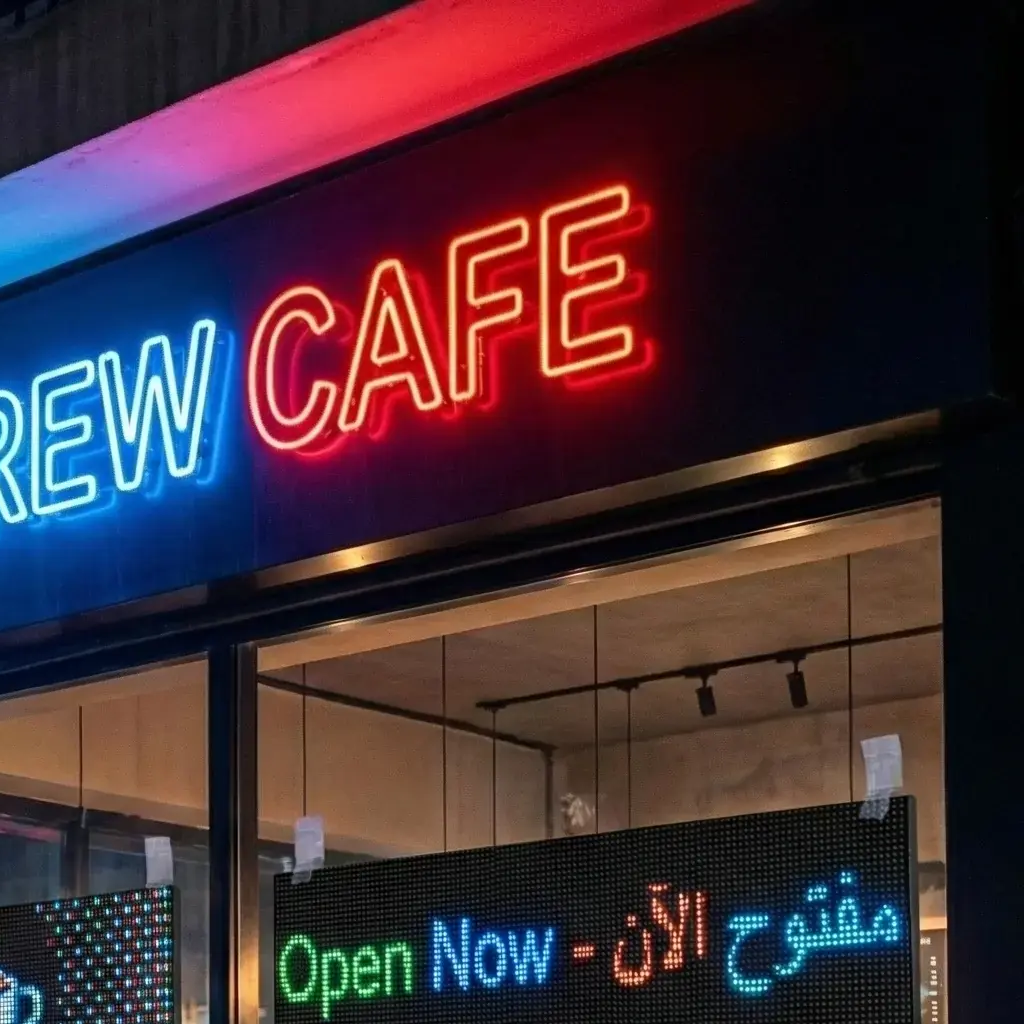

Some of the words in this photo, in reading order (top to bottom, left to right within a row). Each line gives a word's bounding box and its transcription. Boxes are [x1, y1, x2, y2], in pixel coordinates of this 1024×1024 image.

[248, 184, 633, 452] CAFE
[279, 933, 414, 1020] Open
[430, 917, 554, 993] Now
[613, 882, 706, 986] الآن
[727, 871, 899, 992] مفتوح
